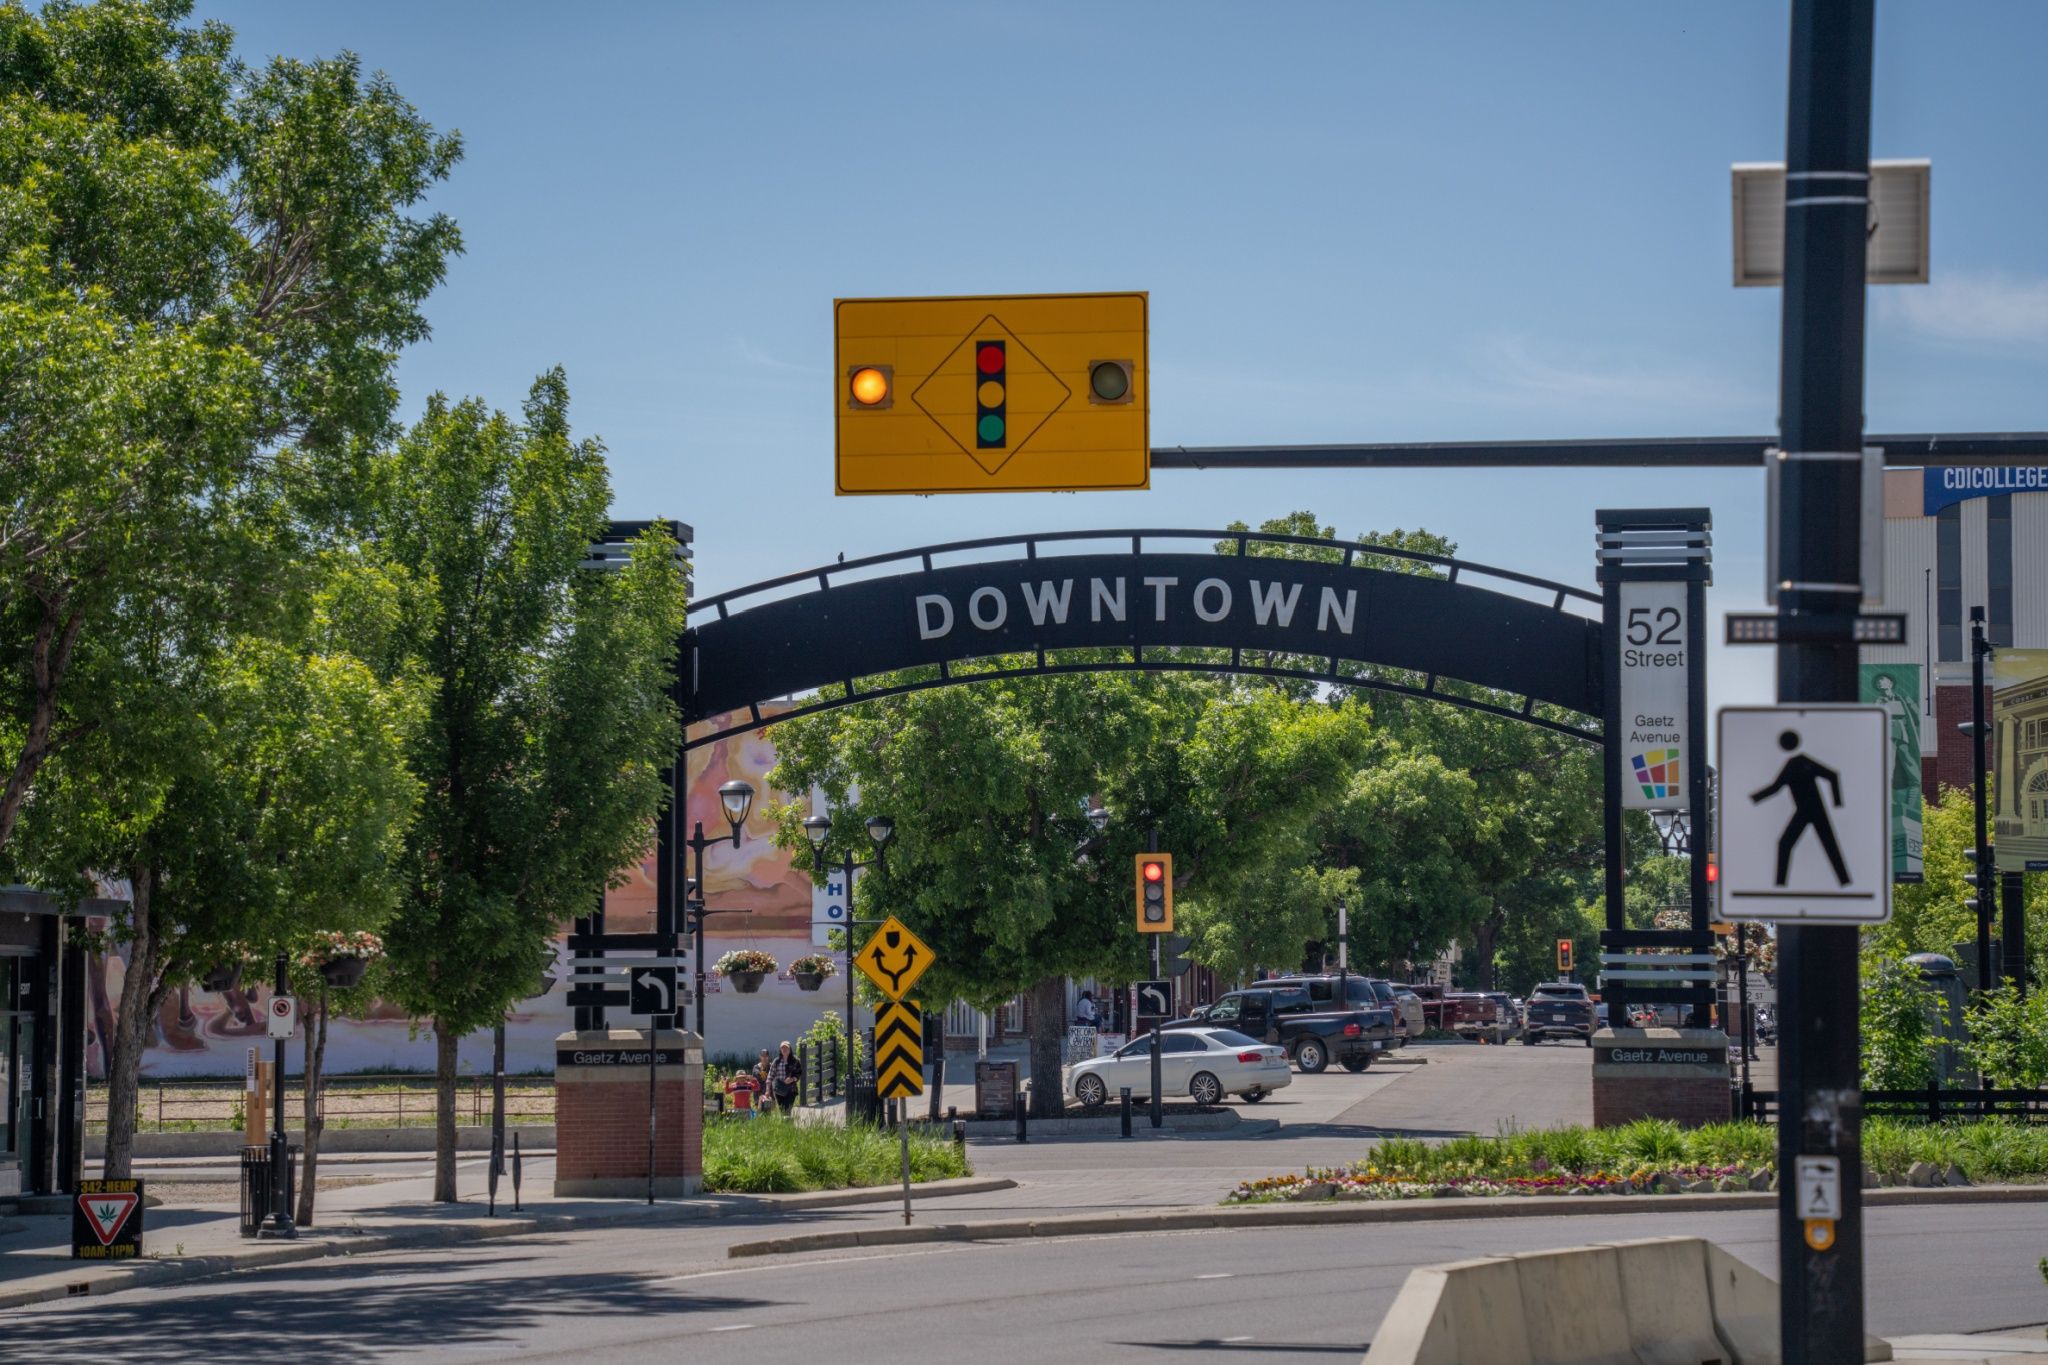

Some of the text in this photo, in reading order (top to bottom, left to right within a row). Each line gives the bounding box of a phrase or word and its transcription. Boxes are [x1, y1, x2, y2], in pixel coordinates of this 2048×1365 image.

[915, 576, 1358, 640] DOWNTOWN
[1626, 607, 1682, 646] 52
[1624, 650, 1684, 668] Street
[1635, 714, 1675, 727] Gaetz
[1630, 731, 1681, 743] Avenue
[573, 1051, 615, 1064] Gaetz
[1611, 1048, 1708, 1062] Gaetz Avenue
[80, 1181, 137, 1193] 342-HEMP
[80, 1244, 135, 1258] 10AM-11PM
